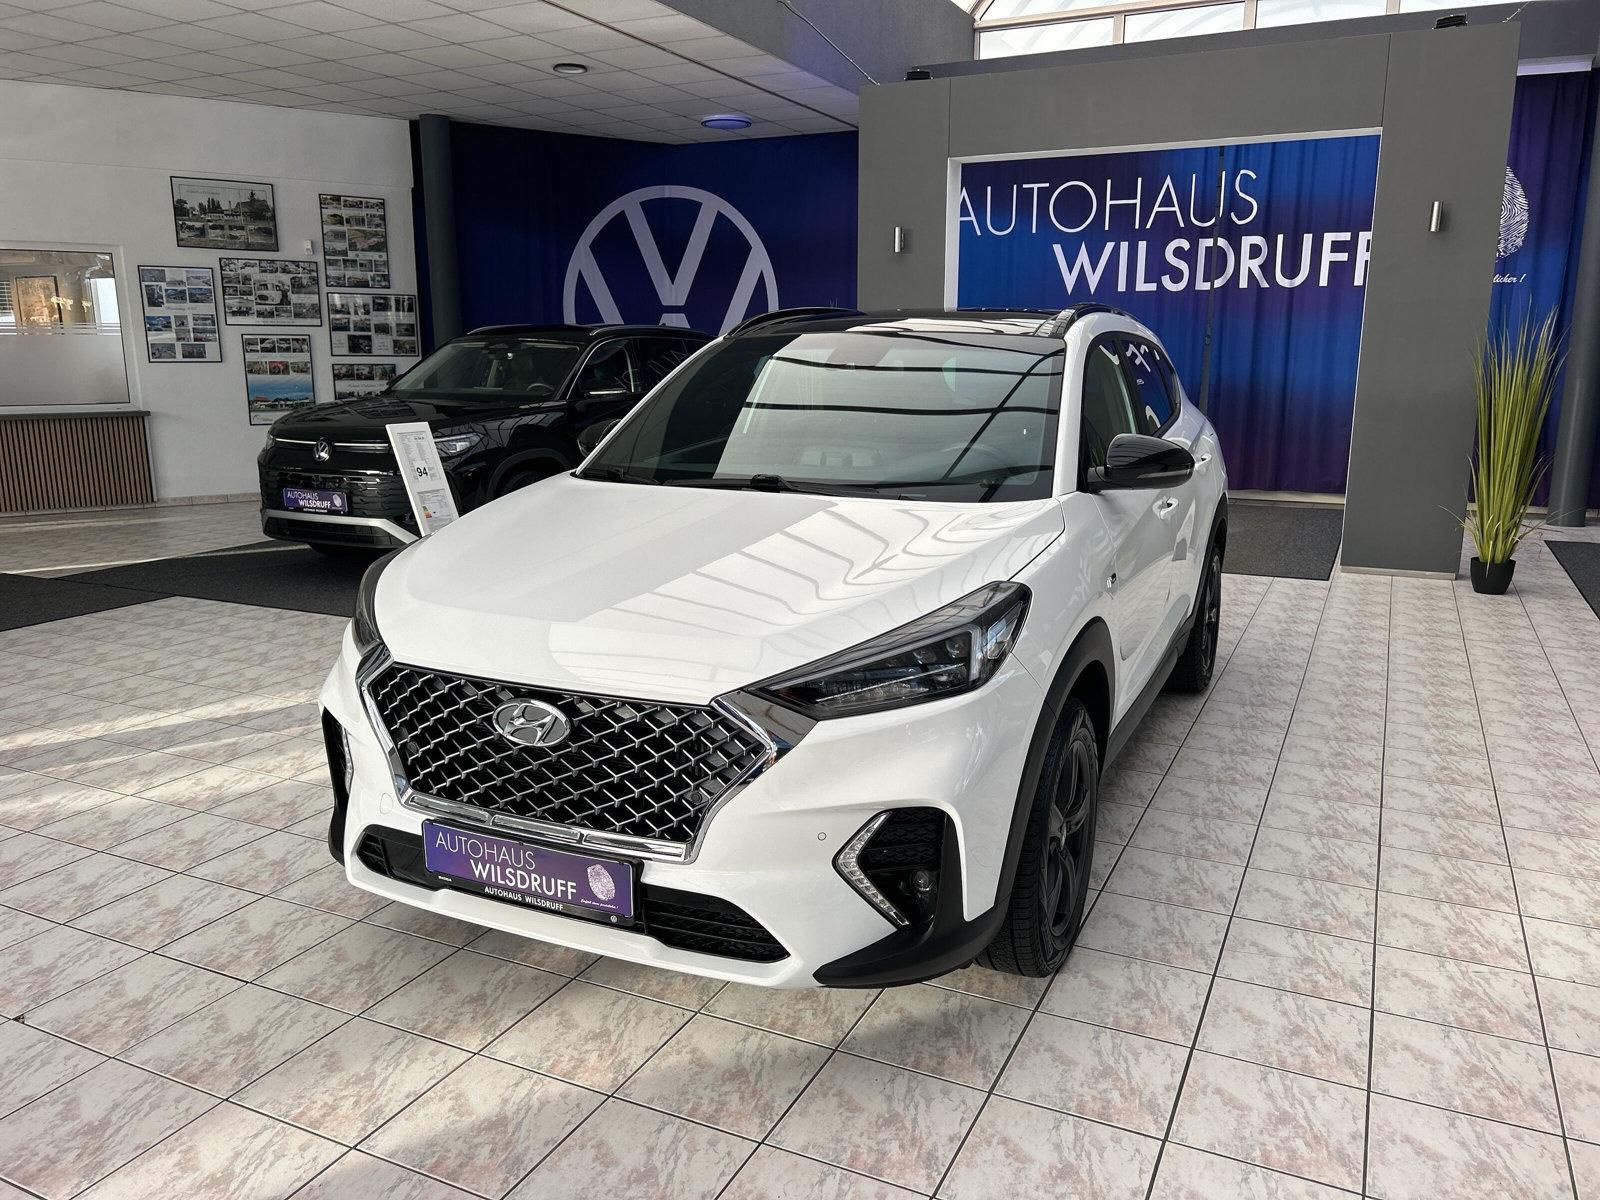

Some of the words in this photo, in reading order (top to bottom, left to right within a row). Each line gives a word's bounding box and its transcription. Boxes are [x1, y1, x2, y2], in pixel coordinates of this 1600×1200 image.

[959, 169, 1258, 236] AUTOHAUS
[1493, 273, 1517, 283] licher
[416, 467, 429, 477] 94
[287, 491, 319, 500] AUTOHAUS
[298, 499, 331, 508] WILSDRUFF
[436, 831, 536, 869] AUTOHAUS
[470, 859, 577, 900] WILSDRUFF
[484, 886, 522, 902] AUTOHAUS
[525, 896, 564, 911] WILSDRUFF
